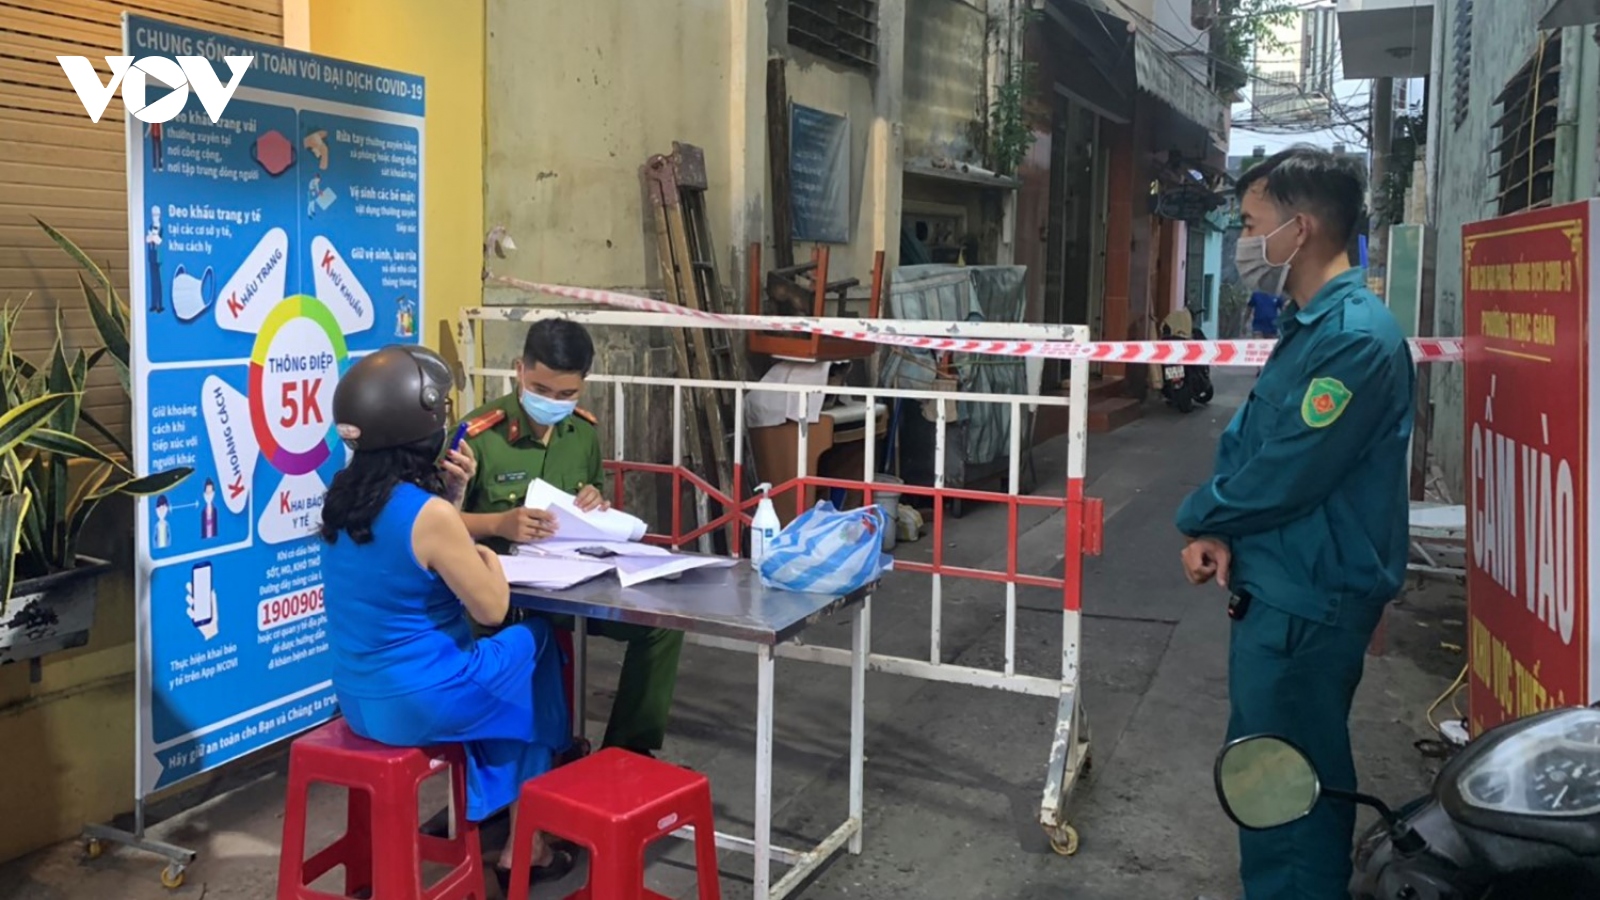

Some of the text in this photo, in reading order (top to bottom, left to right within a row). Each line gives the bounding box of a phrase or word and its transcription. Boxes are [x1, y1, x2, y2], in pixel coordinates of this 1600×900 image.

[136, 27, 193, 56] CHUNG
[262, 51, 297, 76] TOÀN
[300, 59, 320, 80] VỚI
[324, 66, 344, 90] ĐẠI
[346, 70, 373, 93] DỊCH
[375, 78, 423, 100] COVID-19
[168, 204, 262, 224] Đeo khẩu trang y tế
[168, 240, 212, 255] khu cách ly
[256, 248, 283, 284] TRANG
[269, 352, 334, 374] THÔNG ĐIỆP
[152, 403, 197, 419] Giữ khoảng
[213, 386, 230, 425] CÁCH
[280, 378, 324, 428] 5K
[152, 421, 185, 435] cách khi
[152, 437, 198, 452] tiếp xúc với
[152, 454, 196, 470] người khác
[280, 490, 322, 514] KHAI BÁO
[1472, 374, 1575, 645] CẤM VÀO
[292, 512, 309, 529] Y TẾ
[170, 644, 237, 672] Thực hiện khai báo
[169, 680, 174, 691] y
[175, 671, 183, 686] tế
[184, 669, 201, 684] trên
[201, 665, 215, 680] App
[169, 753, 187, 769] Hãy
[189, 744, 206, 764] giữ
[206, 741, 219, 754] an
[220, 732, 240, 750] toàn
[242, 725, 257, 743] cho
[259, 719, 275, 734] Bạn
[276, 713, 286, 725] và
[288, 703, 313, 723] Chúng
[313, 701, 322, 712] ta
